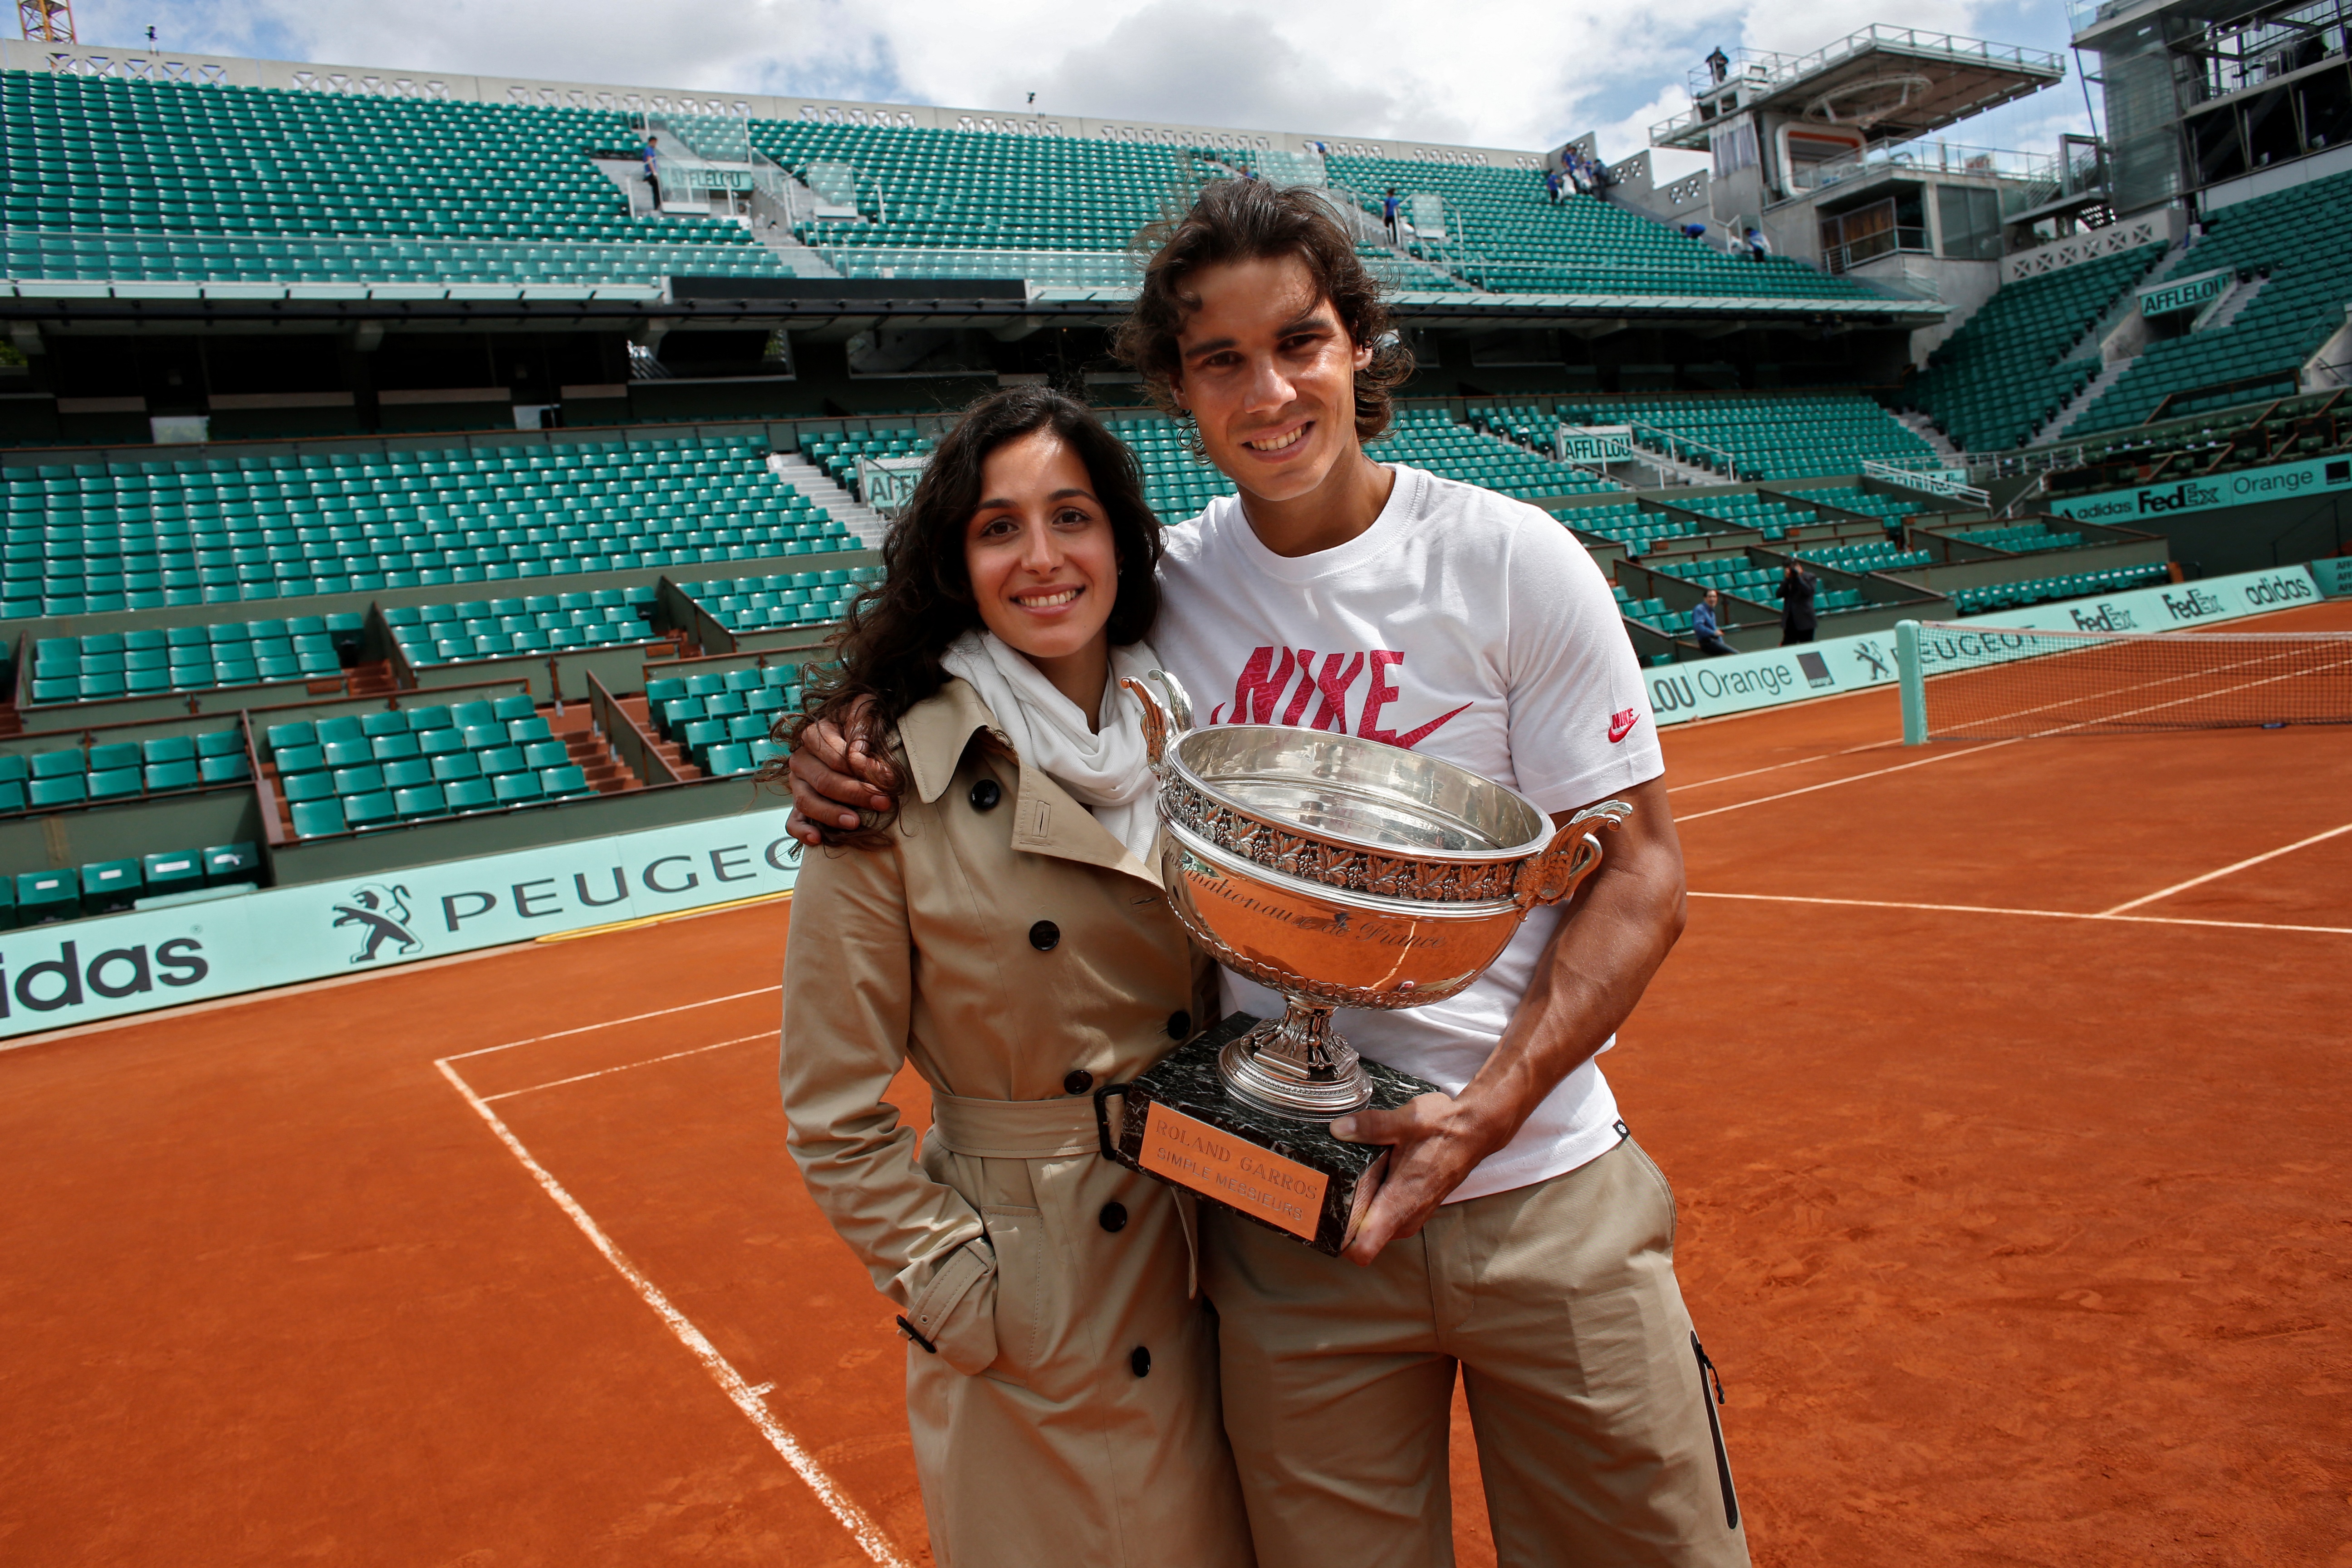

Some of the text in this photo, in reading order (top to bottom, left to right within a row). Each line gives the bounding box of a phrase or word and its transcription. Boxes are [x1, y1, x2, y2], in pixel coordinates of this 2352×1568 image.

[2137, 483, 2220, 514] FedEx
[2233, 471, 2313, 495] Orange
[2077, 501, 2132, 519] adidas
[2161, 588, 2226, 620] FedEx
[2245, 576, 2312, 605] adidas
[2069, 603, 2138, 631] FedEx
[1698, 665, 1793, 698] Orange
[1227, 647, 1405, 749] NIKE
[1612, 707, 1633, 729] NIKE
[1322, 917, 1351, 937] de
[1356, 921, 1448, 949] France
[1156, 1119, 1318, 1200] ROLAND GARROS
[1156, 1147, 1211, 1181] SIMPLE
[1216, 1172, 1303, 1220] MESSIEURS
